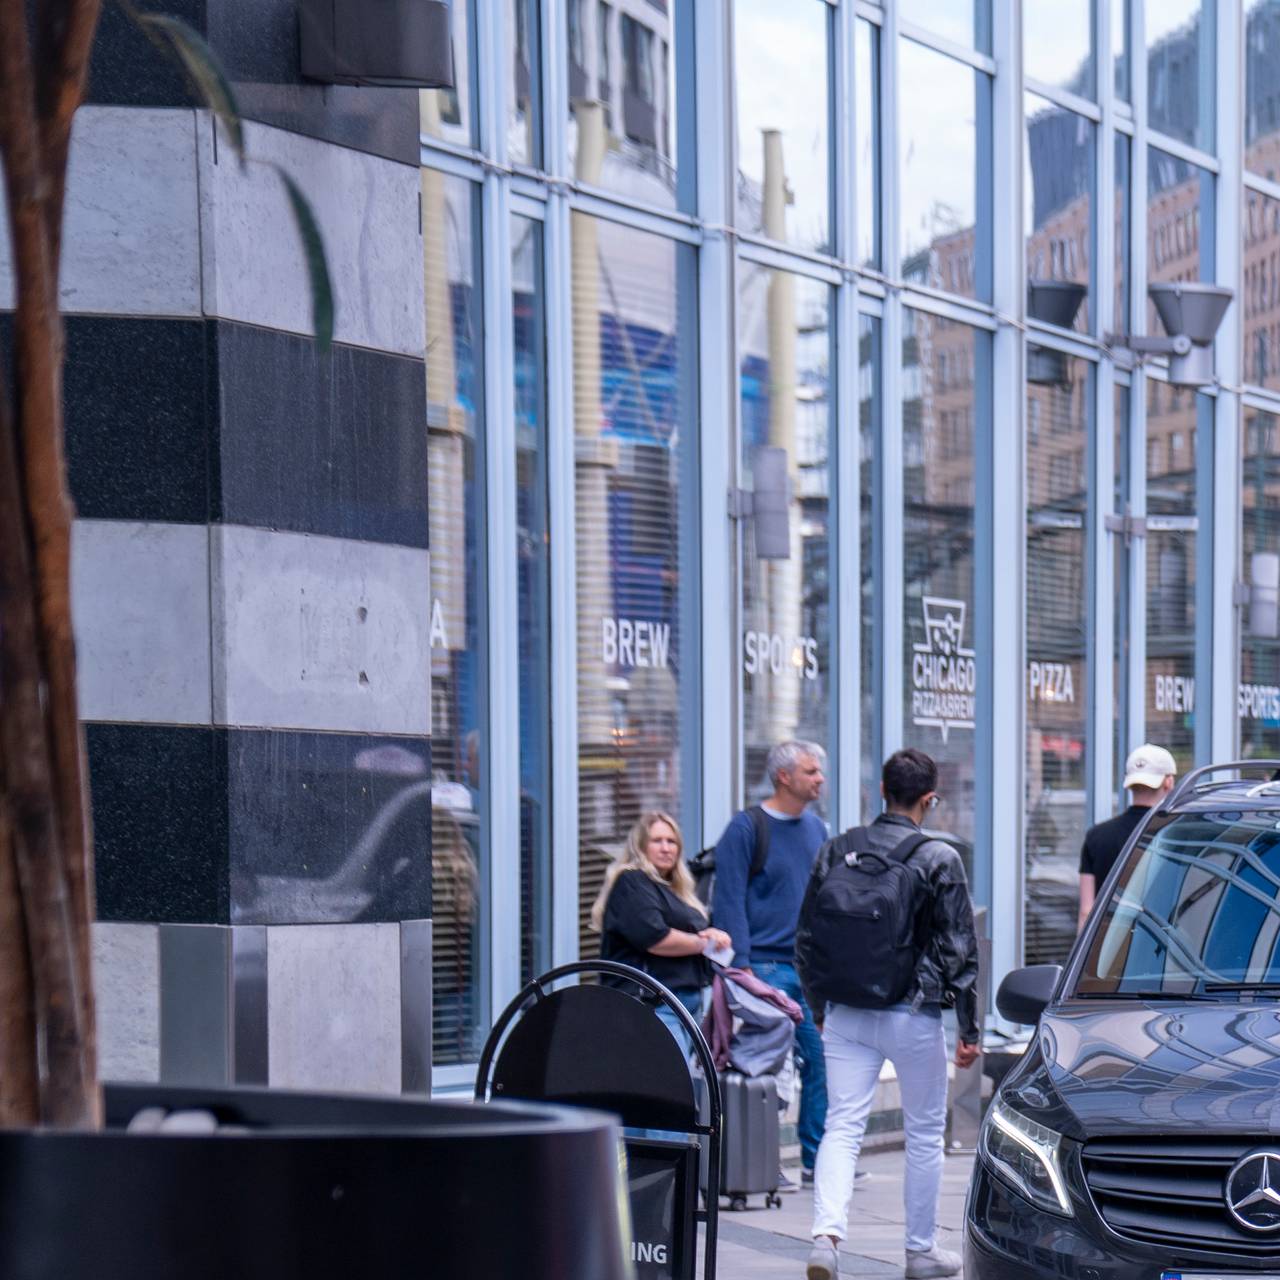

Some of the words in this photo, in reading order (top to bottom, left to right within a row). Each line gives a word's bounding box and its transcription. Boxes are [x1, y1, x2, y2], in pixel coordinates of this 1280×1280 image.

[601, 616, 671, 668] BREW
[912, 652, 977, 693] CHICAGO
[1029, 660, 1075, 703] PIZZA
[1155, 674, 1195, 713] BREW
